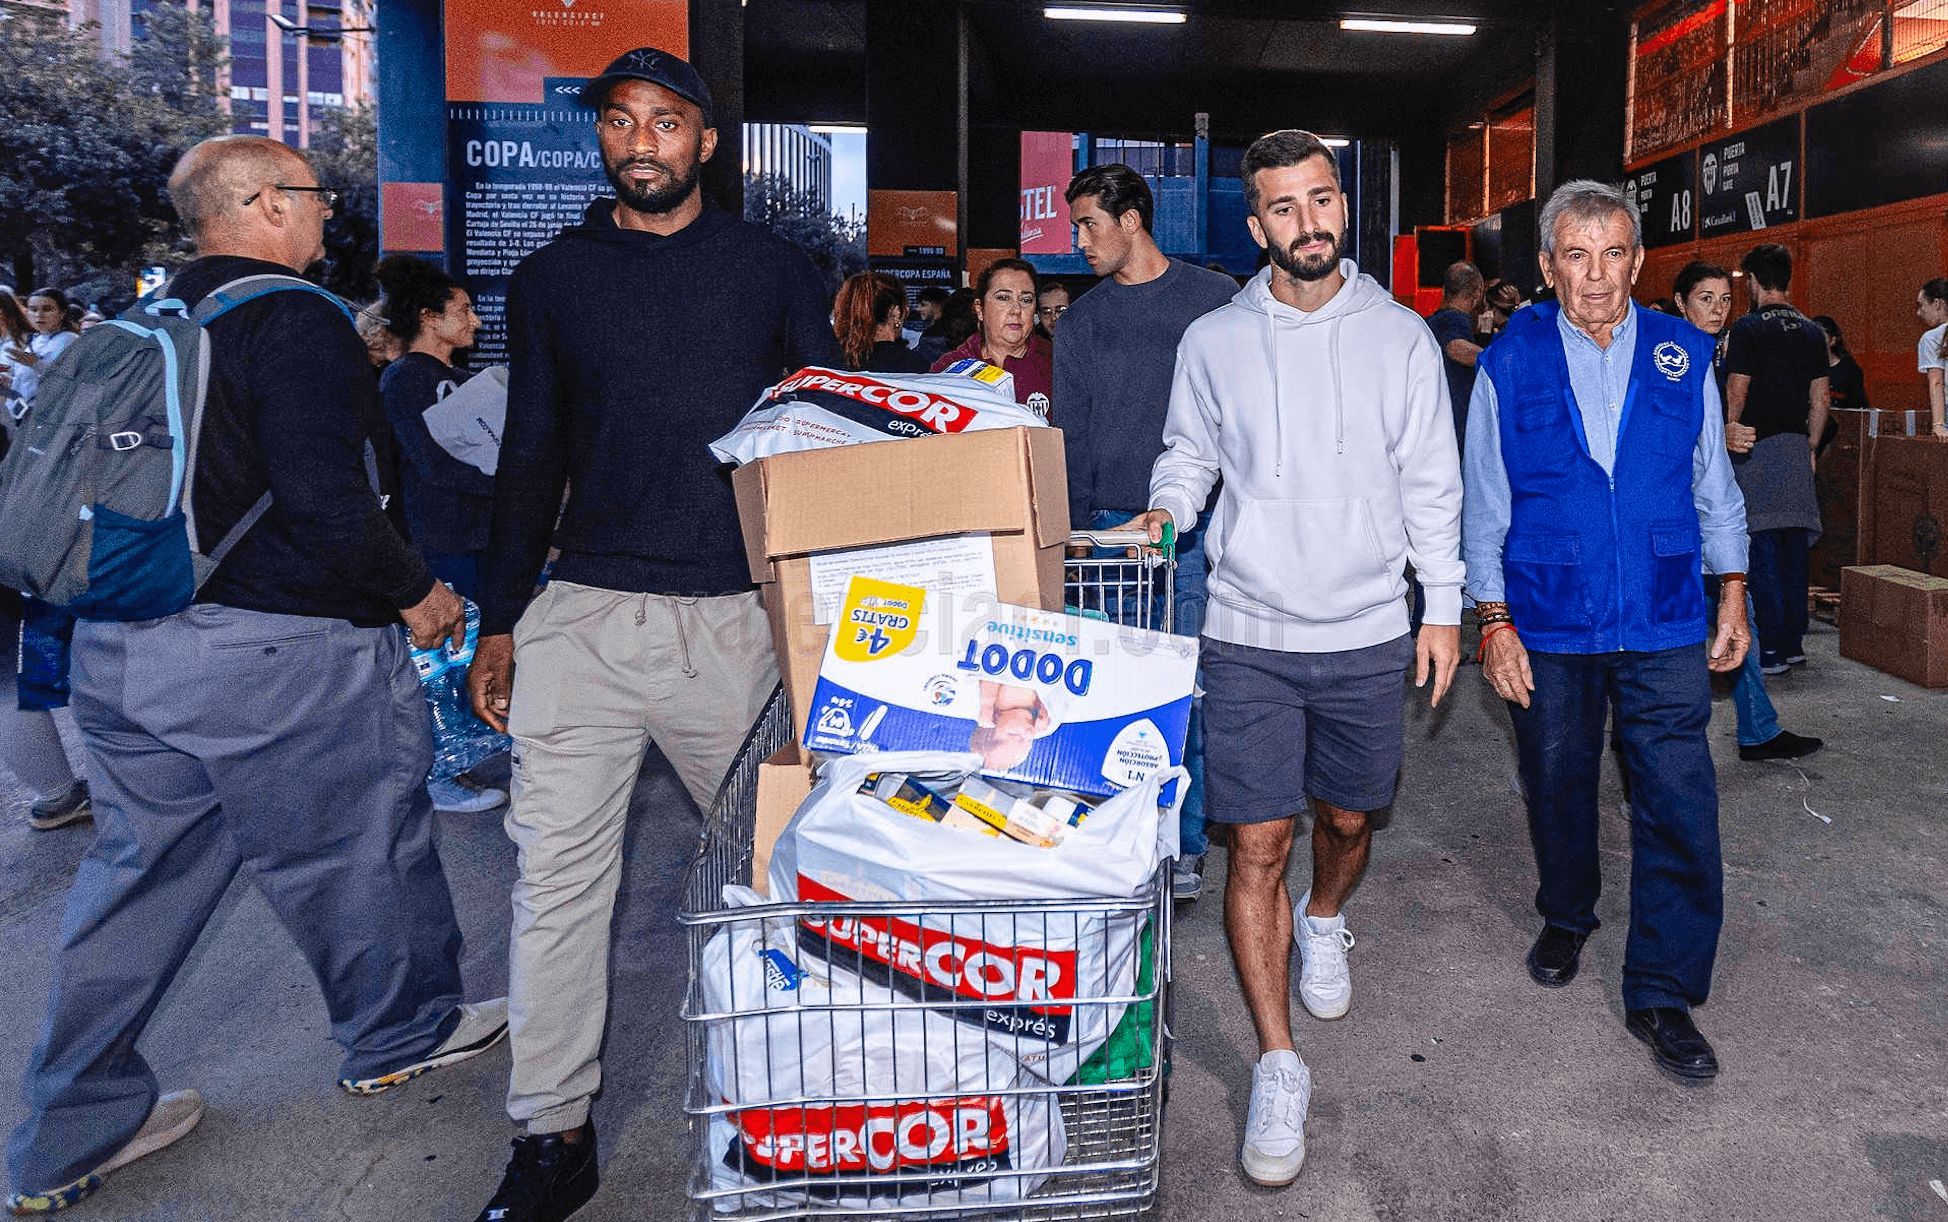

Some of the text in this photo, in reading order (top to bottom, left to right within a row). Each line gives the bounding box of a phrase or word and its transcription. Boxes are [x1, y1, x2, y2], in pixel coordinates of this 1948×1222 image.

[466, 140, 601, 169] COPA/COPA/C
[1723, 141, 1745, 160] PUERTA
[1766, 160, 1792, 212] A7
[1020, 186, 1058, 221] TEL
[1670, 189, 1692, 232] A8
[887, 420, 933, 438] expr
[852, 608, 909, 630] GRATIS
[985, 619, 1078, 647] sensitive
[855, 627, 892, 655] 4€
[957, 638, 1094, 697] DODOT
[985, 1008, 1057, 1040] exprés
[742, 1108, 992, 1170] UPERCOR
